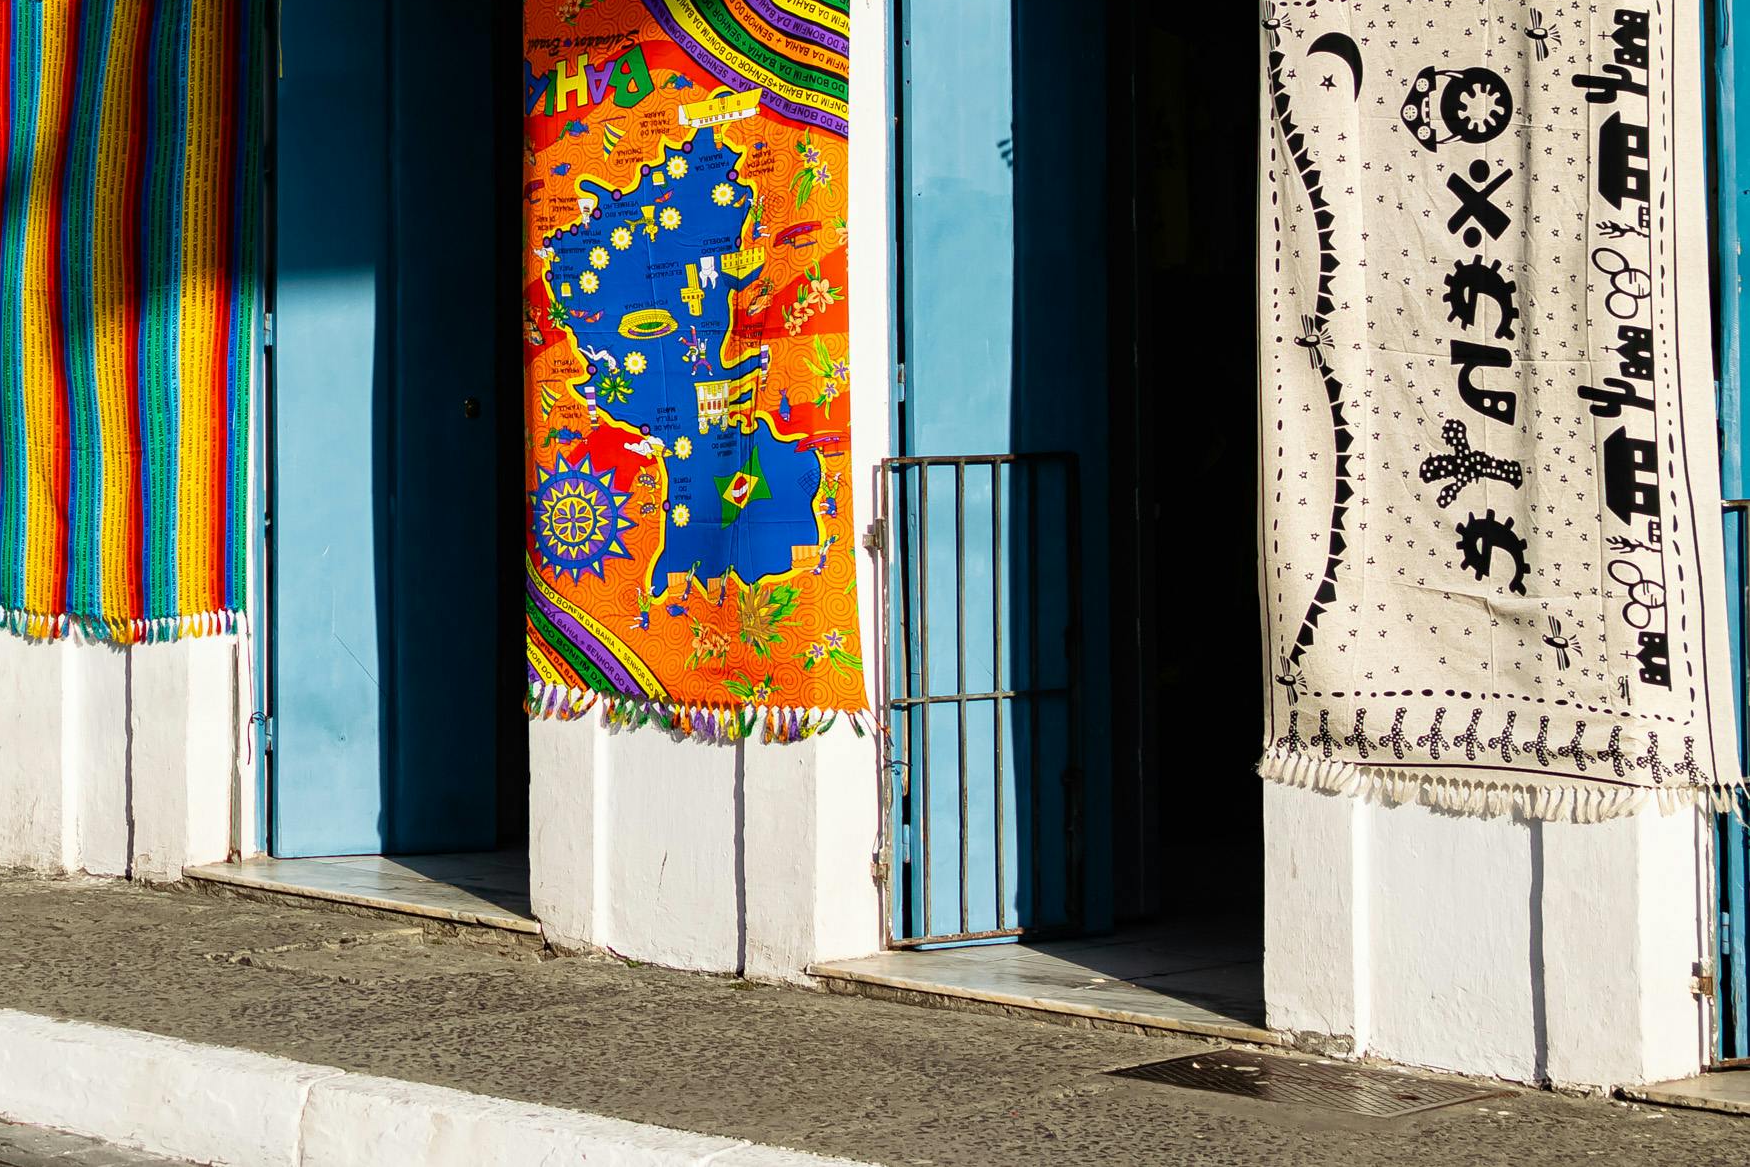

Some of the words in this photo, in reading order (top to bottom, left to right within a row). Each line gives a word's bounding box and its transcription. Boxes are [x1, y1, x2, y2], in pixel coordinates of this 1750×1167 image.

[735, 3, 746, 17] DO
[818, 9, 830, 21] DA
[693, 17, 705, 31] DA
[712, 9, 742, 44] SENHOR
[743, 10, 775, 43] SENHOR
[778, 17, 792, 28] DA
[700, 26, 727, 56] BONFIM
[793, 22, 827, 44] BONFIM
[785, 40, 811, 57] BAHIA
[827, 37, 839, 49] DO
[697, 50, 729, 79] SENHOR
[724, 52, 738, 65] DO
[747, 43, 778, 70] BAHIA
[812, 51, 825, 63] DA
[735, 59, 775, 88] SENHOR
[779, 62, 793, 75] DA
[523, 45, 655, 117] BAHIA
[793, 69, 830, 90] BONFIM
[832, 82, 846, 94] DO
[778, 81, 805, 99] BAHIA
[805, 91, 819, 103] DA
[783, 103, 819, 121] BONFIM
[820, 114, 833, 126] DO
[543, 586, 555, 599] DO
[556, 596, 585, 622] BONFIM
[584, 618, 595, 631] DA
[594, 627, 615, 648] BAHIA
[622, 652, 645, 680] SENHOR
[555, 636, 590, 672] BONFIM
[590, 671, 602, 686] DA
[556, 617, 579, 642] BAHIA
[586, 644, 615, 675] SENHOR
[613, 674, 625, 687] DO
[553, 657, 563, 669] DA
